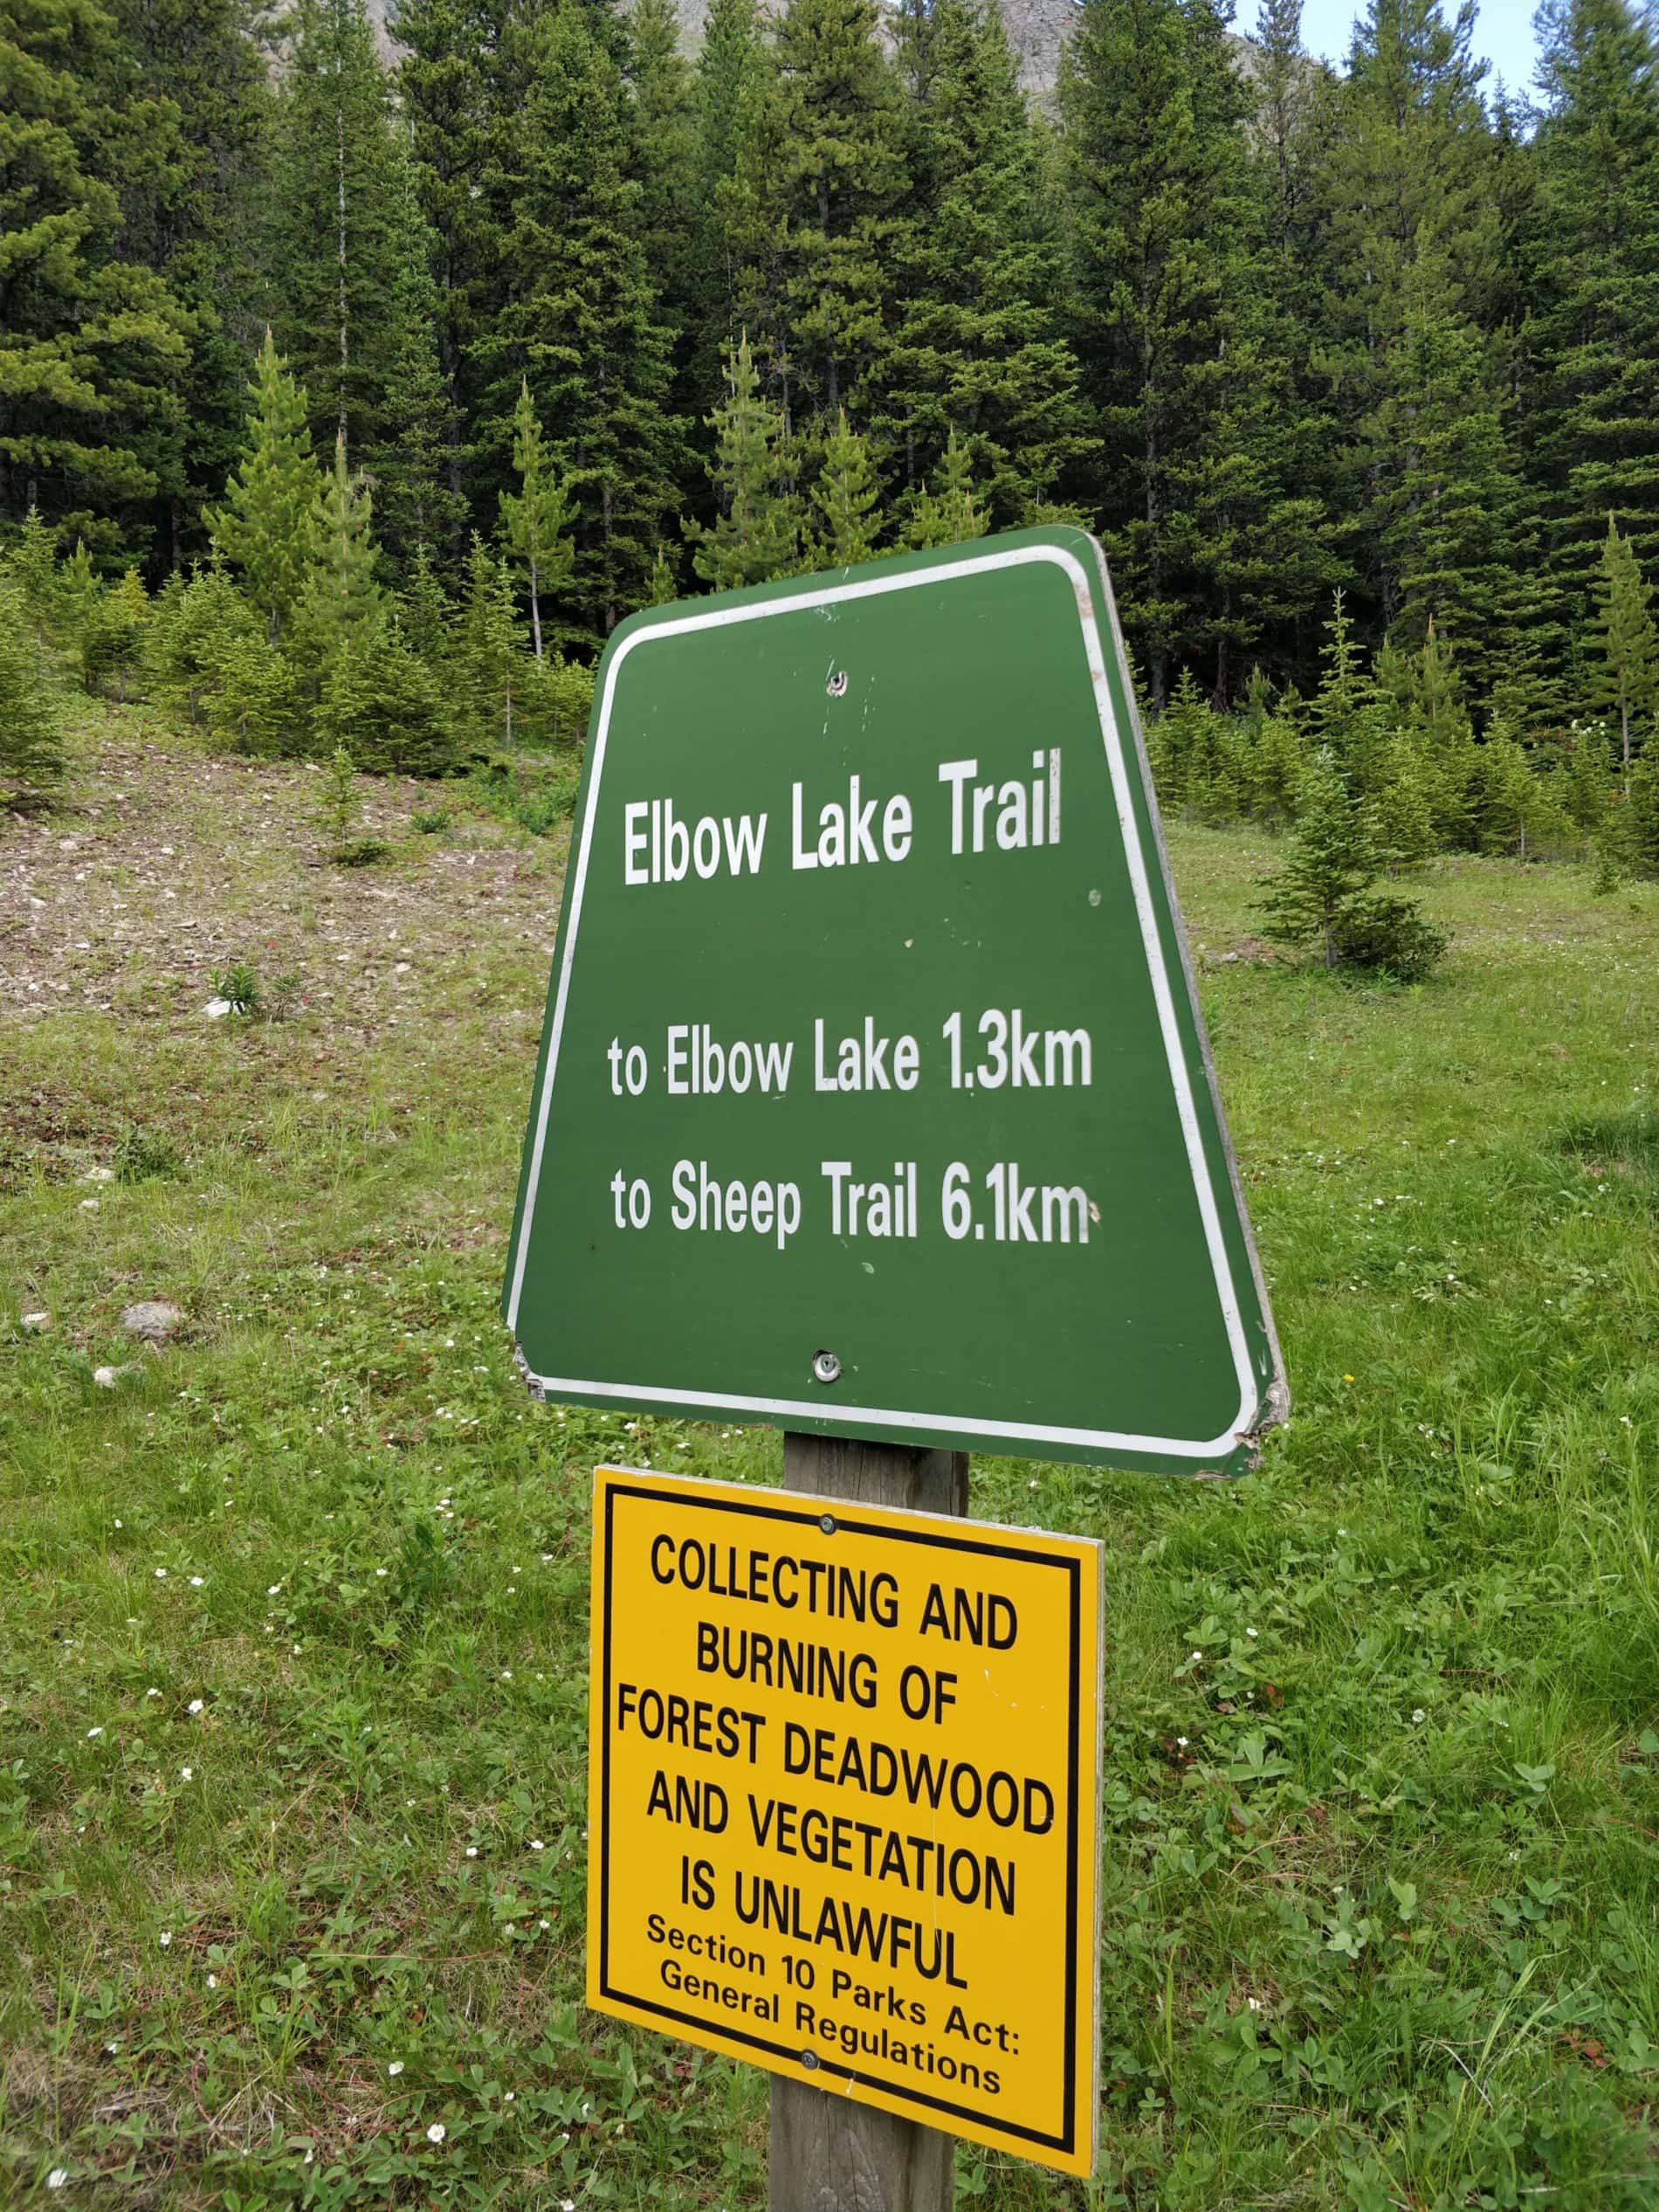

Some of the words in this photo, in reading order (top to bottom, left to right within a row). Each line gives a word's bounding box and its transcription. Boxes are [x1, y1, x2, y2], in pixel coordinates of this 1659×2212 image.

[623, 798, 768, 885] Elbow
[790, 775, 913, 872] Lake
[938, 748, 1062, 856] Trail
[608, 1036, 648, 1096] to
[666, 1024, 794, 1095] Elbow
[814, 1016, 919, 1092] Lake
[942, 1010, 1092, 1089] 1.3km
[610, 1168, 651, 1230] to
[671, 1160, 802, 1250] Sheep
[822, 1161, 918, 1237] Trail
[941, 1161, 1090, 1244] 6.1km
[651, 1533, 898, 1628] COLLECTING
[919, 1583, 1017, 1650] AND
[697, 1621, 877, 1708] BURNING
[899, 1665, 958, 1725] OF
[618, 1683, 766, 1764] FOREST
[784, 1722, 1055, 1834] DEADWOOD
[646, 1768, 728, 1835] AND
[747, 1793, 1015, 1916] VEGETATION
[647, 1914, 766, 1975] Section
[781, 1955, 816, 1990] 10
[833, 1969, 926, 2026] Parks
[944, 2007, 1019, 2055] Act:
[681, 1855, 715, 1911] IS
[734, 1871, 967, 1989] UNLAWFUL
[661, 1960, 780, 2023] General
[795, 2002, 1002, 2095] Regulations
